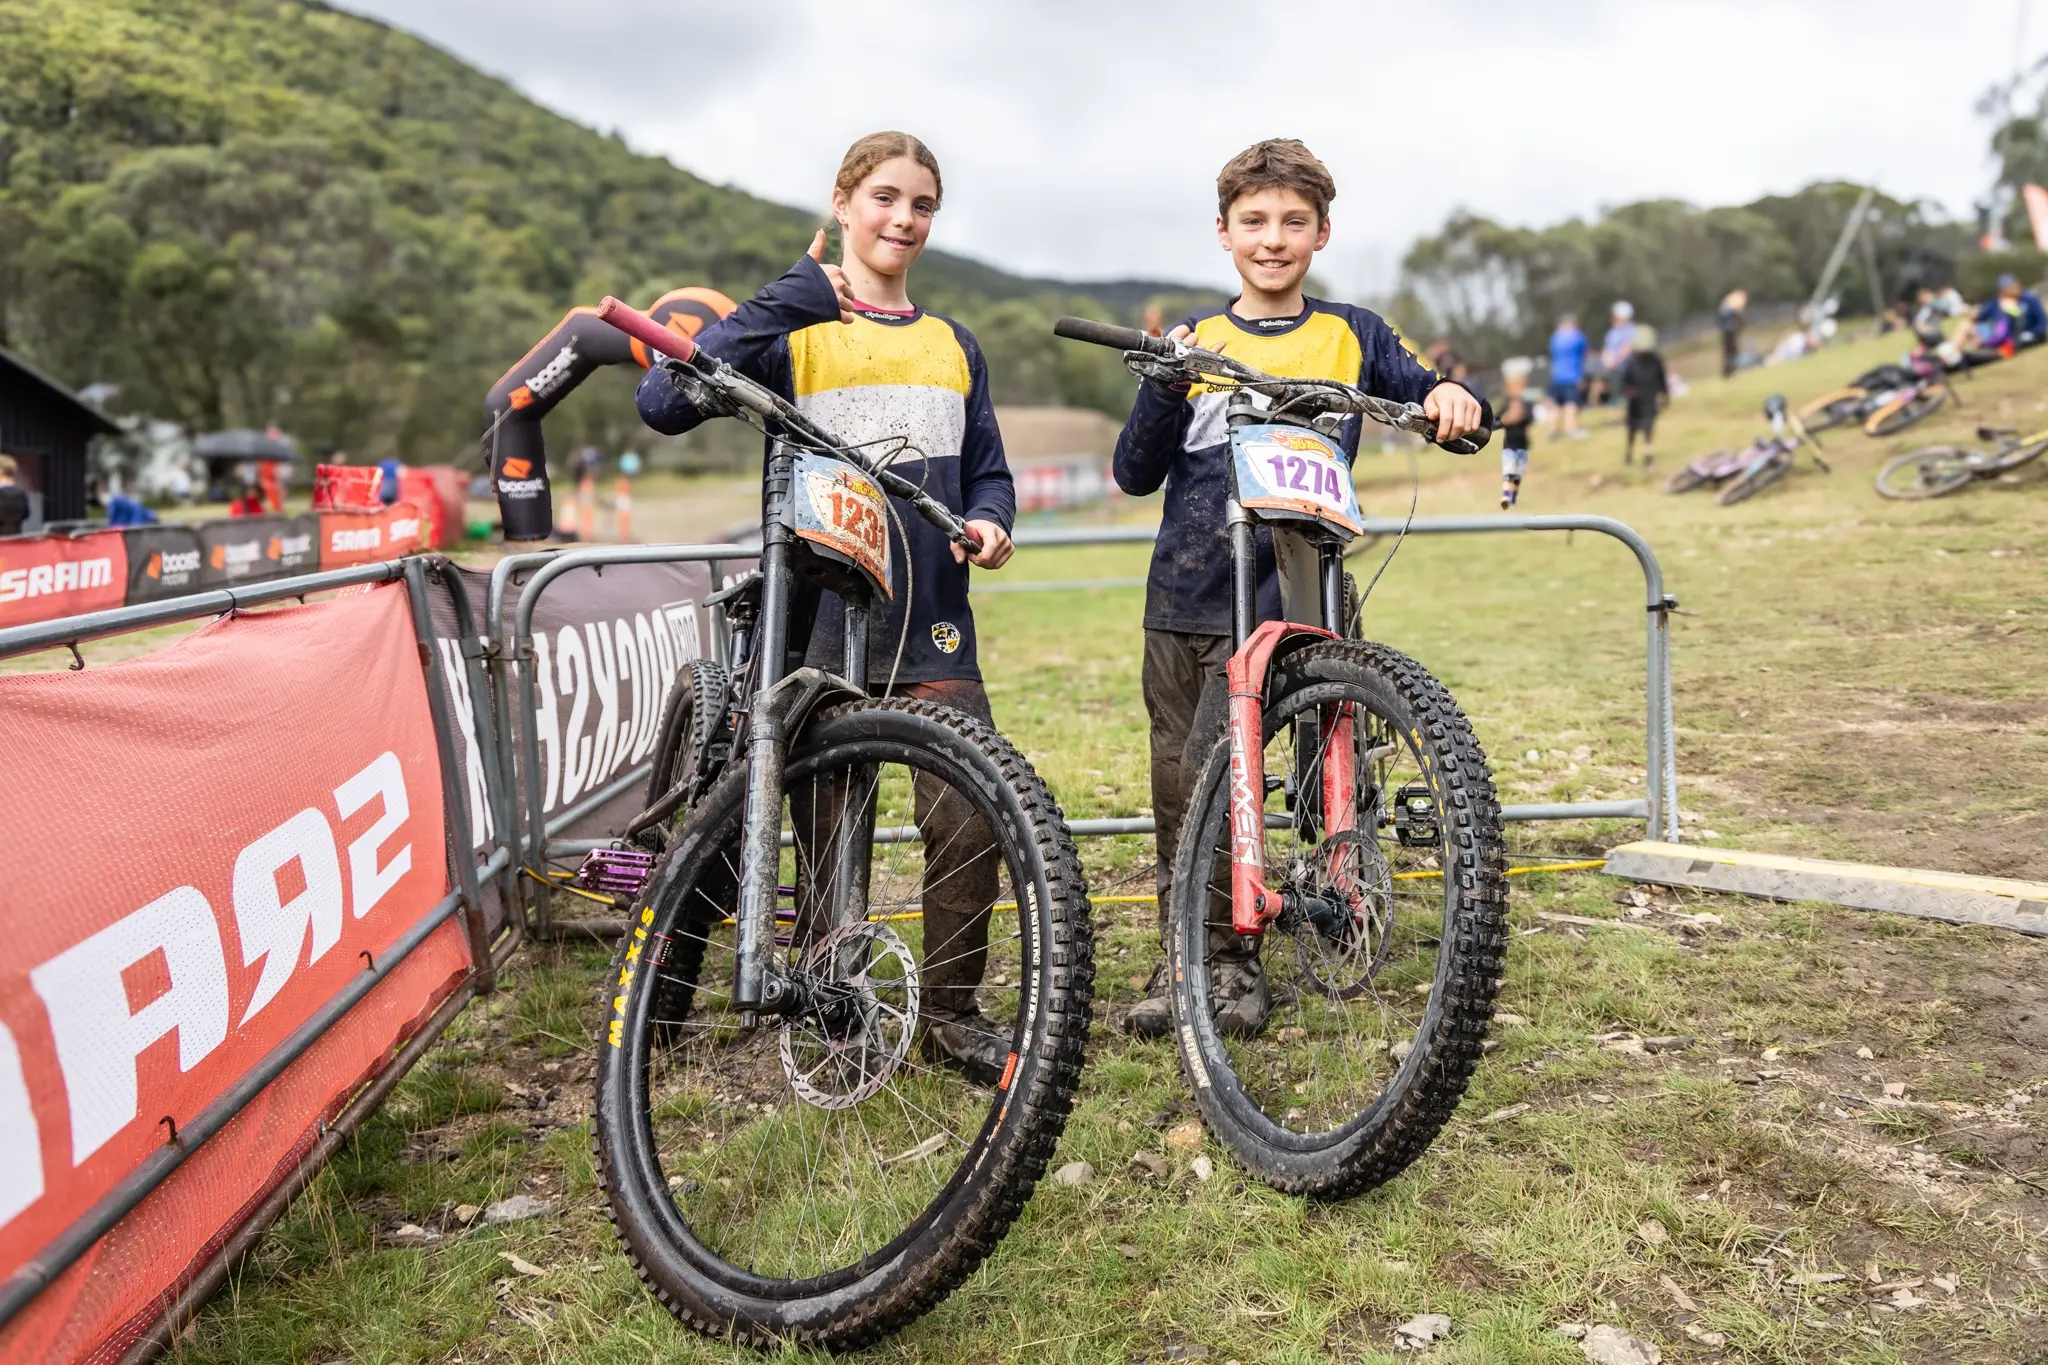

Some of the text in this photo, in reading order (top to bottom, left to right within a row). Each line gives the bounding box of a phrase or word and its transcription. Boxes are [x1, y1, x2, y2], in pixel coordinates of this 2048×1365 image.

[1266, 454, 1342, 504] 1274
[161, 549, 201, 574] boost
[331, 527, 382, 553] SRAM
[0, 557, 112, 603] SRAM
[1026, 881, 1041, 966] MINION
[608, 906, 655, 1049] MAXXIS
